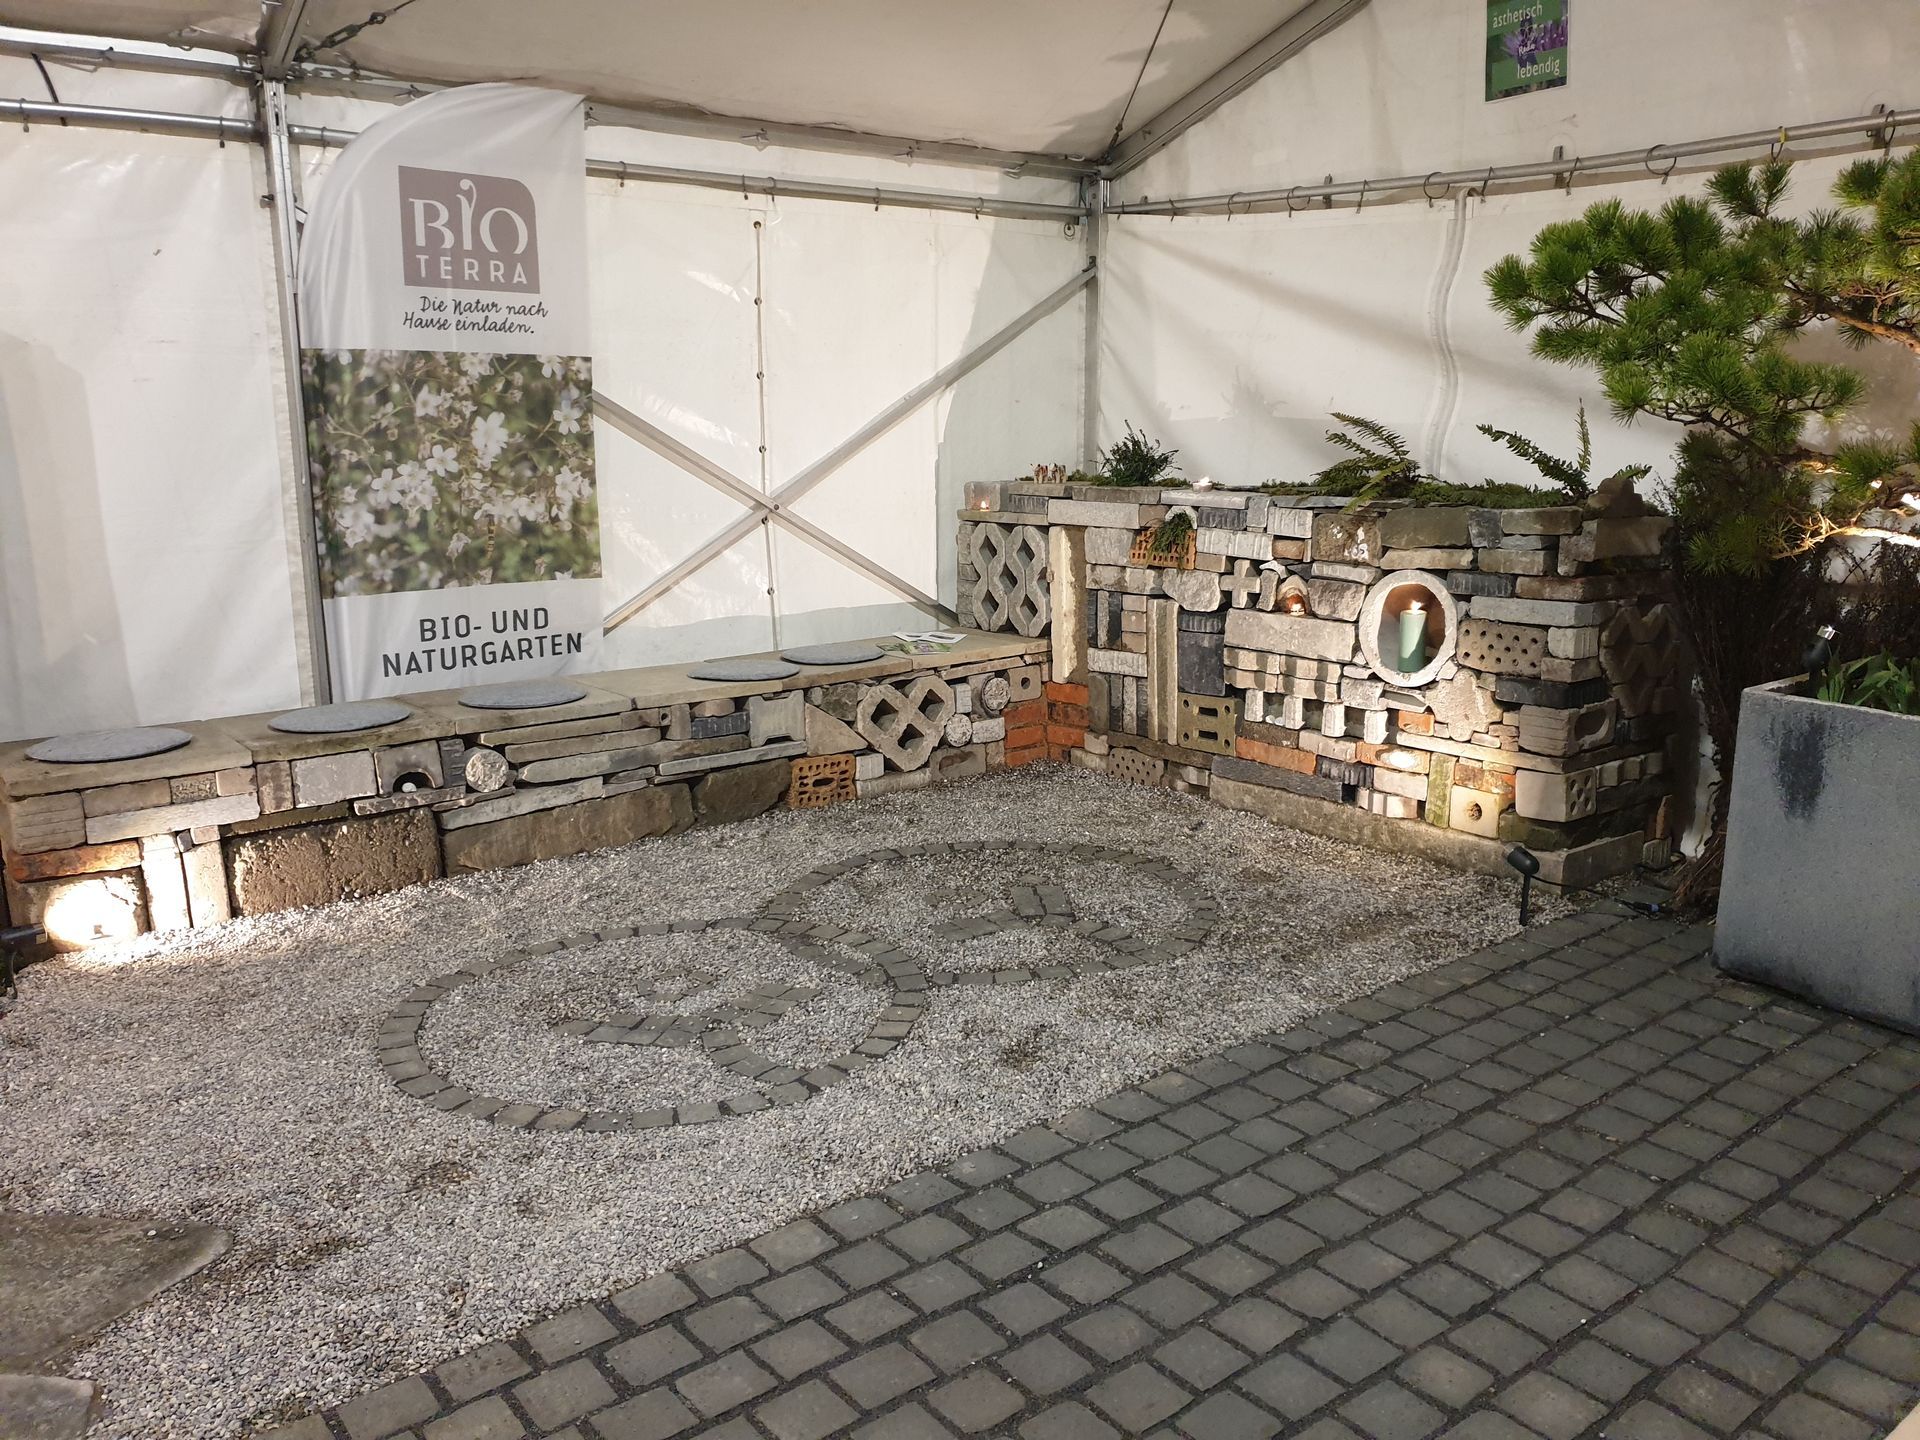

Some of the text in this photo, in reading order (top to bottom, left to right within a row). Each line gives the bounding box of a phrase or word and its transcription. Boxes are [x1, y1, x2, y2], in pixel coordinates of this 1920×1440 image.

[1517, 57, 1560, 79] lebendig
[415, 254, 528, 285] TERRA
[419, 295, 549, 318] Die Natur nach
[403, 311, 535, 335] Hause einladen.
[418, 607, 549, 643] BIO- UND
[382, 632, 583, 678] NATURGARTEN
